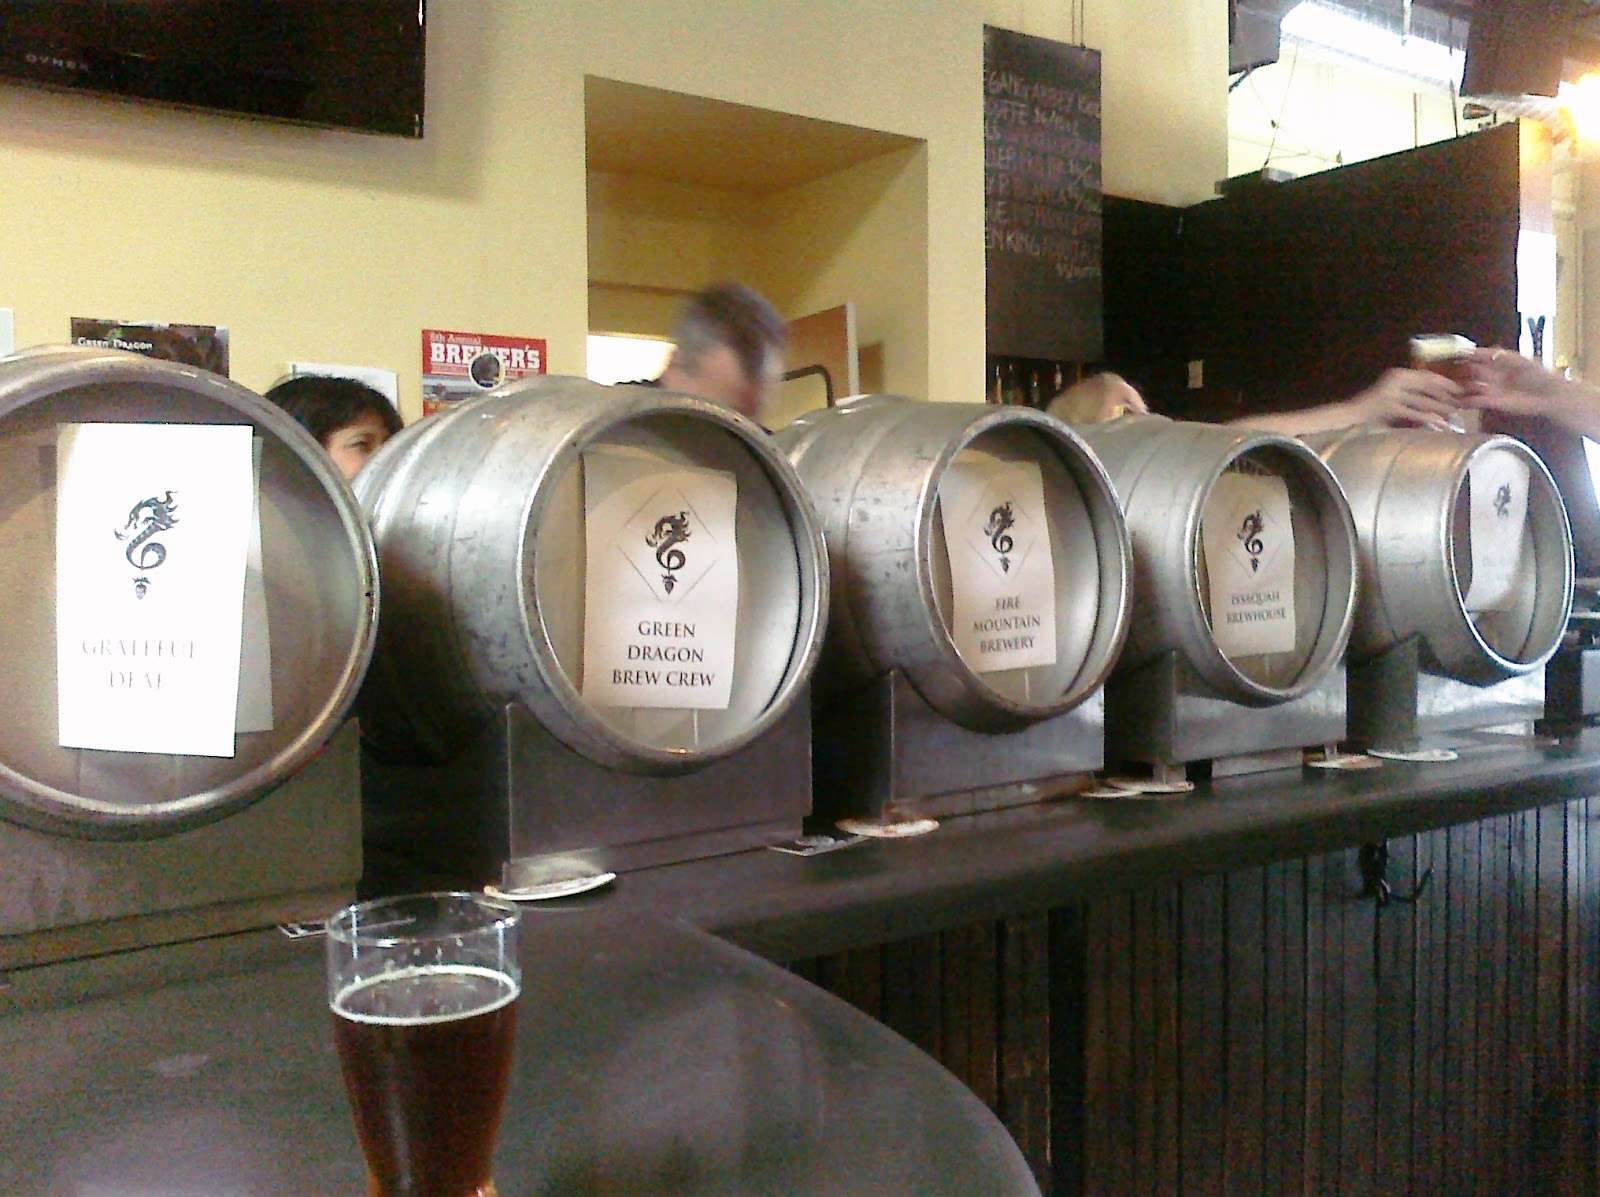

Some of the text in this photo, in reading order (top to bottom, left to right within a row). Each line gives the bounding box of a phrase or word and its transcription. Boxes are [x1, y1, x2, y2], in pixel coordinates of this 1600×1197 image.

[995, 596, 1020, 610] FIRE
[638, 621, 695, 637] GREEN
[973, 615, 1040, 632] MOUNTAIN
[980, 636, 1034, 653] BREWERY
[627, 645, 703, 662] DRAGON
[613, 669, 715, 687] BREW CREW
